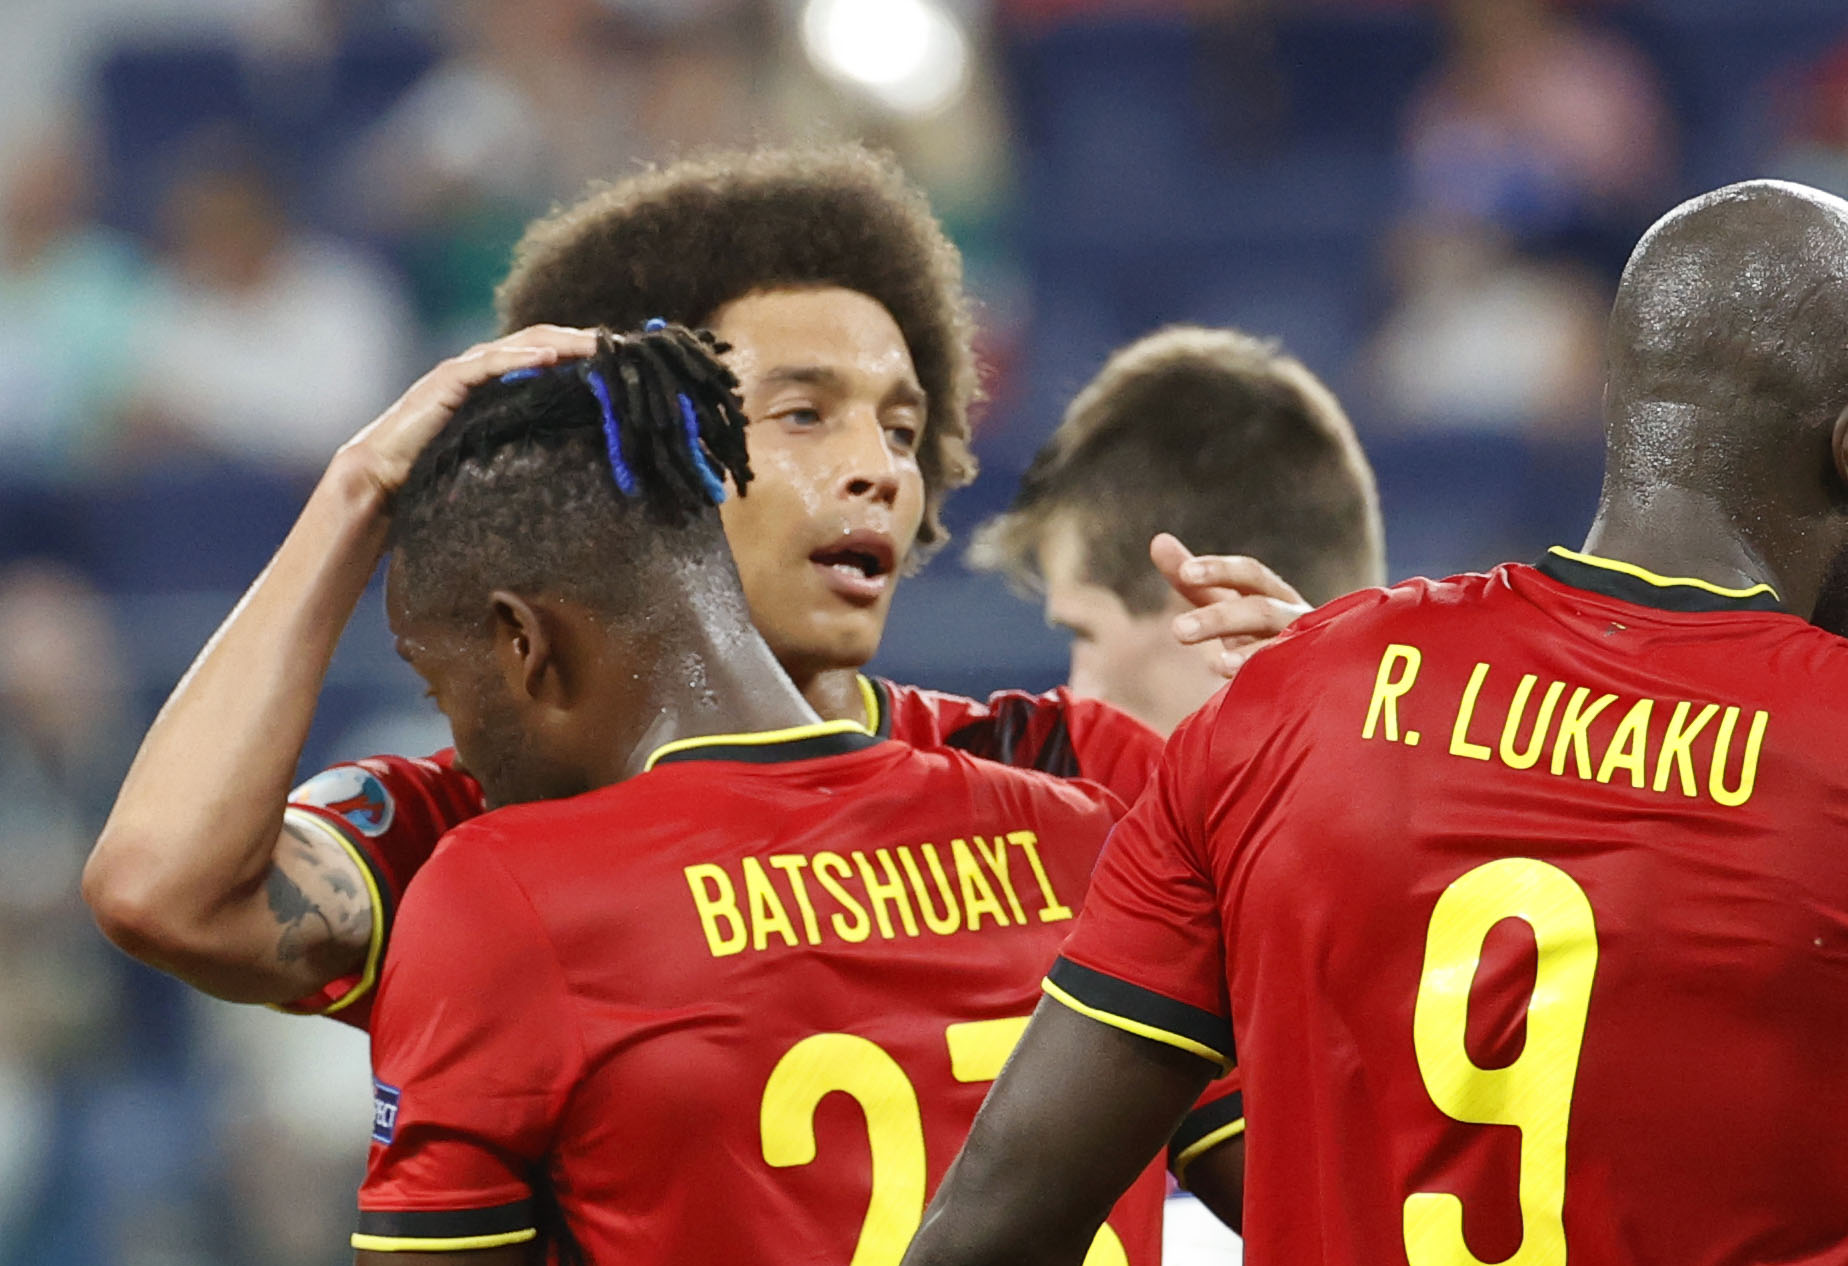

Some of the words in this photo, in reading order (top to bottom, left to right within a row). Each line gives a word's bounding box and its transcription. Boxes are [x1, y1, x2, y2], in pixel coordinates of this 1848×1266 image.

[1361, 643, 1421, 747] R.
[1449, 661, 1769, 806] LUKAKU
[684, 829, 1073, 957] BATSHUAYI
